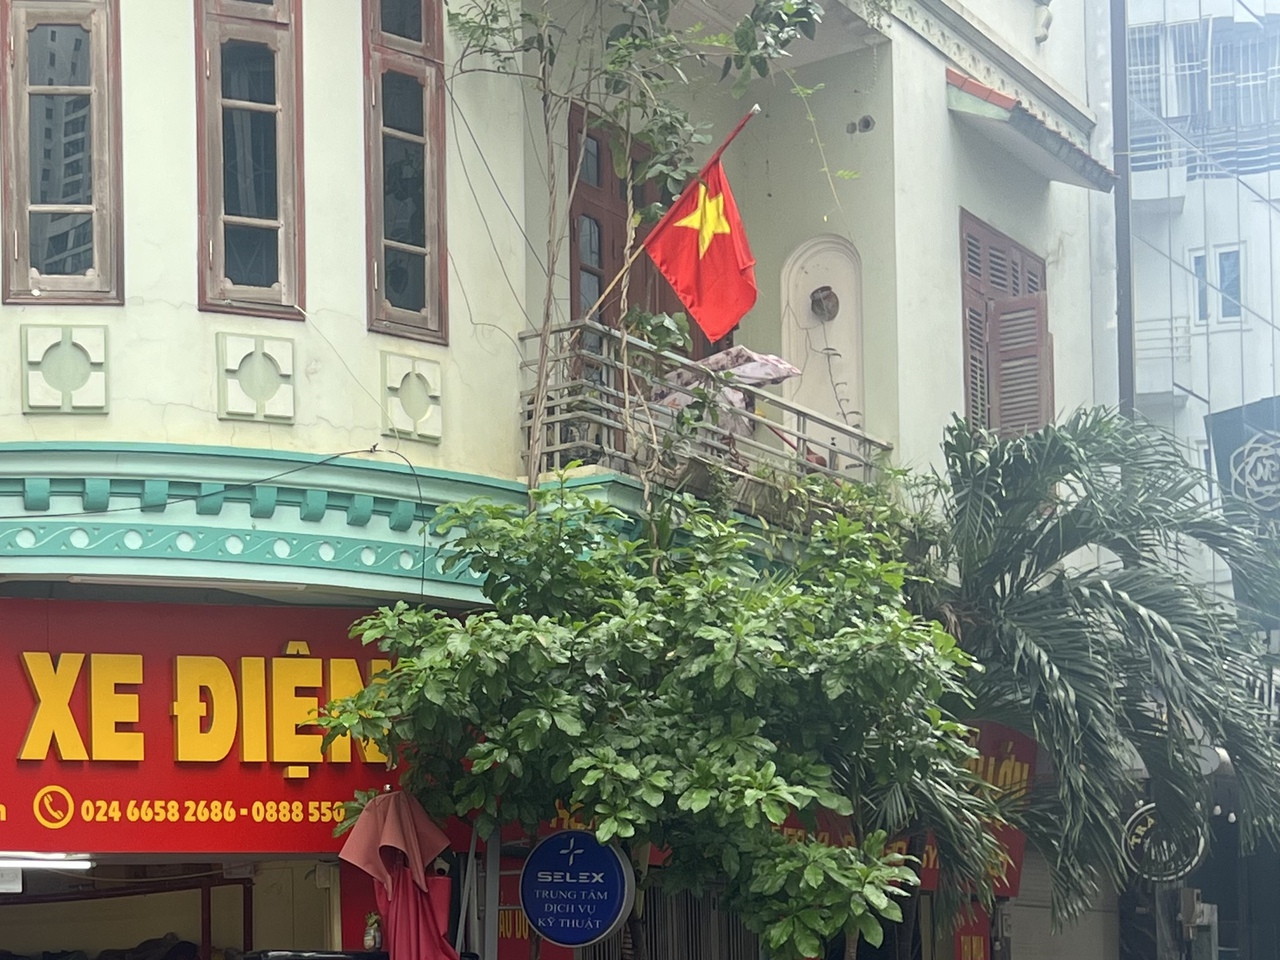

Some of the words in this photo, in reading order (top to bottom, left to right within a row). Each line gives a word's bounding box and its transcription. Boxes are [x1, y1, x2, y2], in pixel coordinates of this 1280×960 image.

[19, 651, 145, 761] XE
[173, 641, 394, 778] ĐIỆN
[81, 800, 121, 822] 024
[126, 800, 180, 822] 6658
[184, 800, 236, 822] 2686
[252, 801, 304, 822] 0888
[537, 871, 605, 883] SELEX
[534, 889, 577, 899] TRUNG
[581, 889, 608, 900] TÂM
[544, 903, 574, 914] DỊCH
[578, 904, 596, 915] VỤ
[538, 917, 557, 927] KỸ
[560, 917, 601, 930] THUẬT
